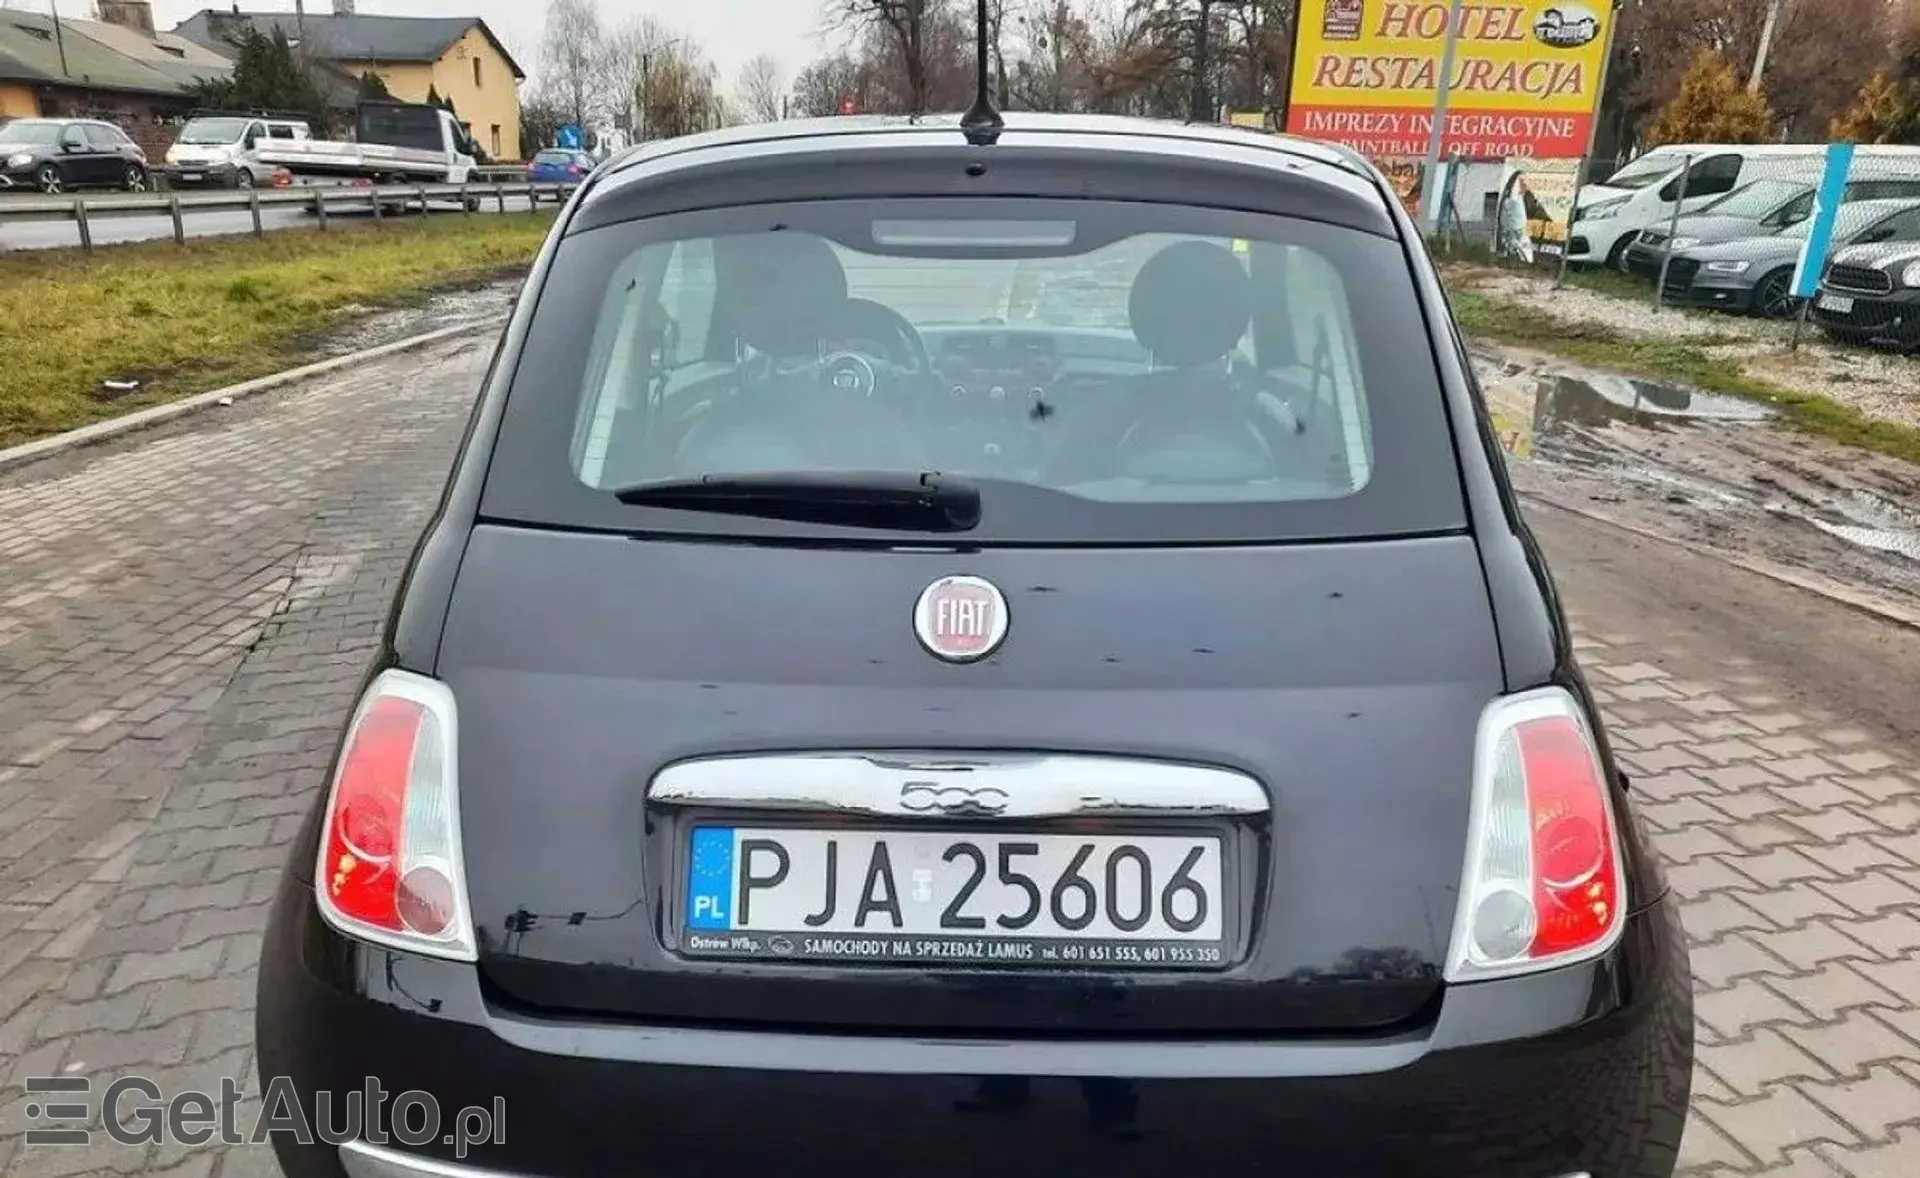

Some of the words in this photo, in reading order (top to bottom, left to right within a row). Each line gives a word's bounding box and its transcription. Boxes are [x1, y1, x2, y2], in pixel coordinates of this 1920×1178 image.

[1375, 3, 1526, 40] HOTEL
[1304, 110, 1404, 134] IMPREZY
[1448, 142, 1480, 156] OFF
[1485, 143, 1534, 157] ROAD
[937, 598, 988, 636] FIAT
[900, 780, 1010, 814] 500
[737, 839, 904, 928] PJA
[939, 841, 1207, 934] 25606
[694, 895, 724, 920] PL
[805, 938, 889, 955] SAMOCHODY
[893, 940, 912, 956] NA
[916, 939, 985, 958] SPRZEDAŻ
[988, 942, 1034, 959] LAMUS
[1063, 945, 1085, 960] 601
[1089, 946, 1110, 960] 651
